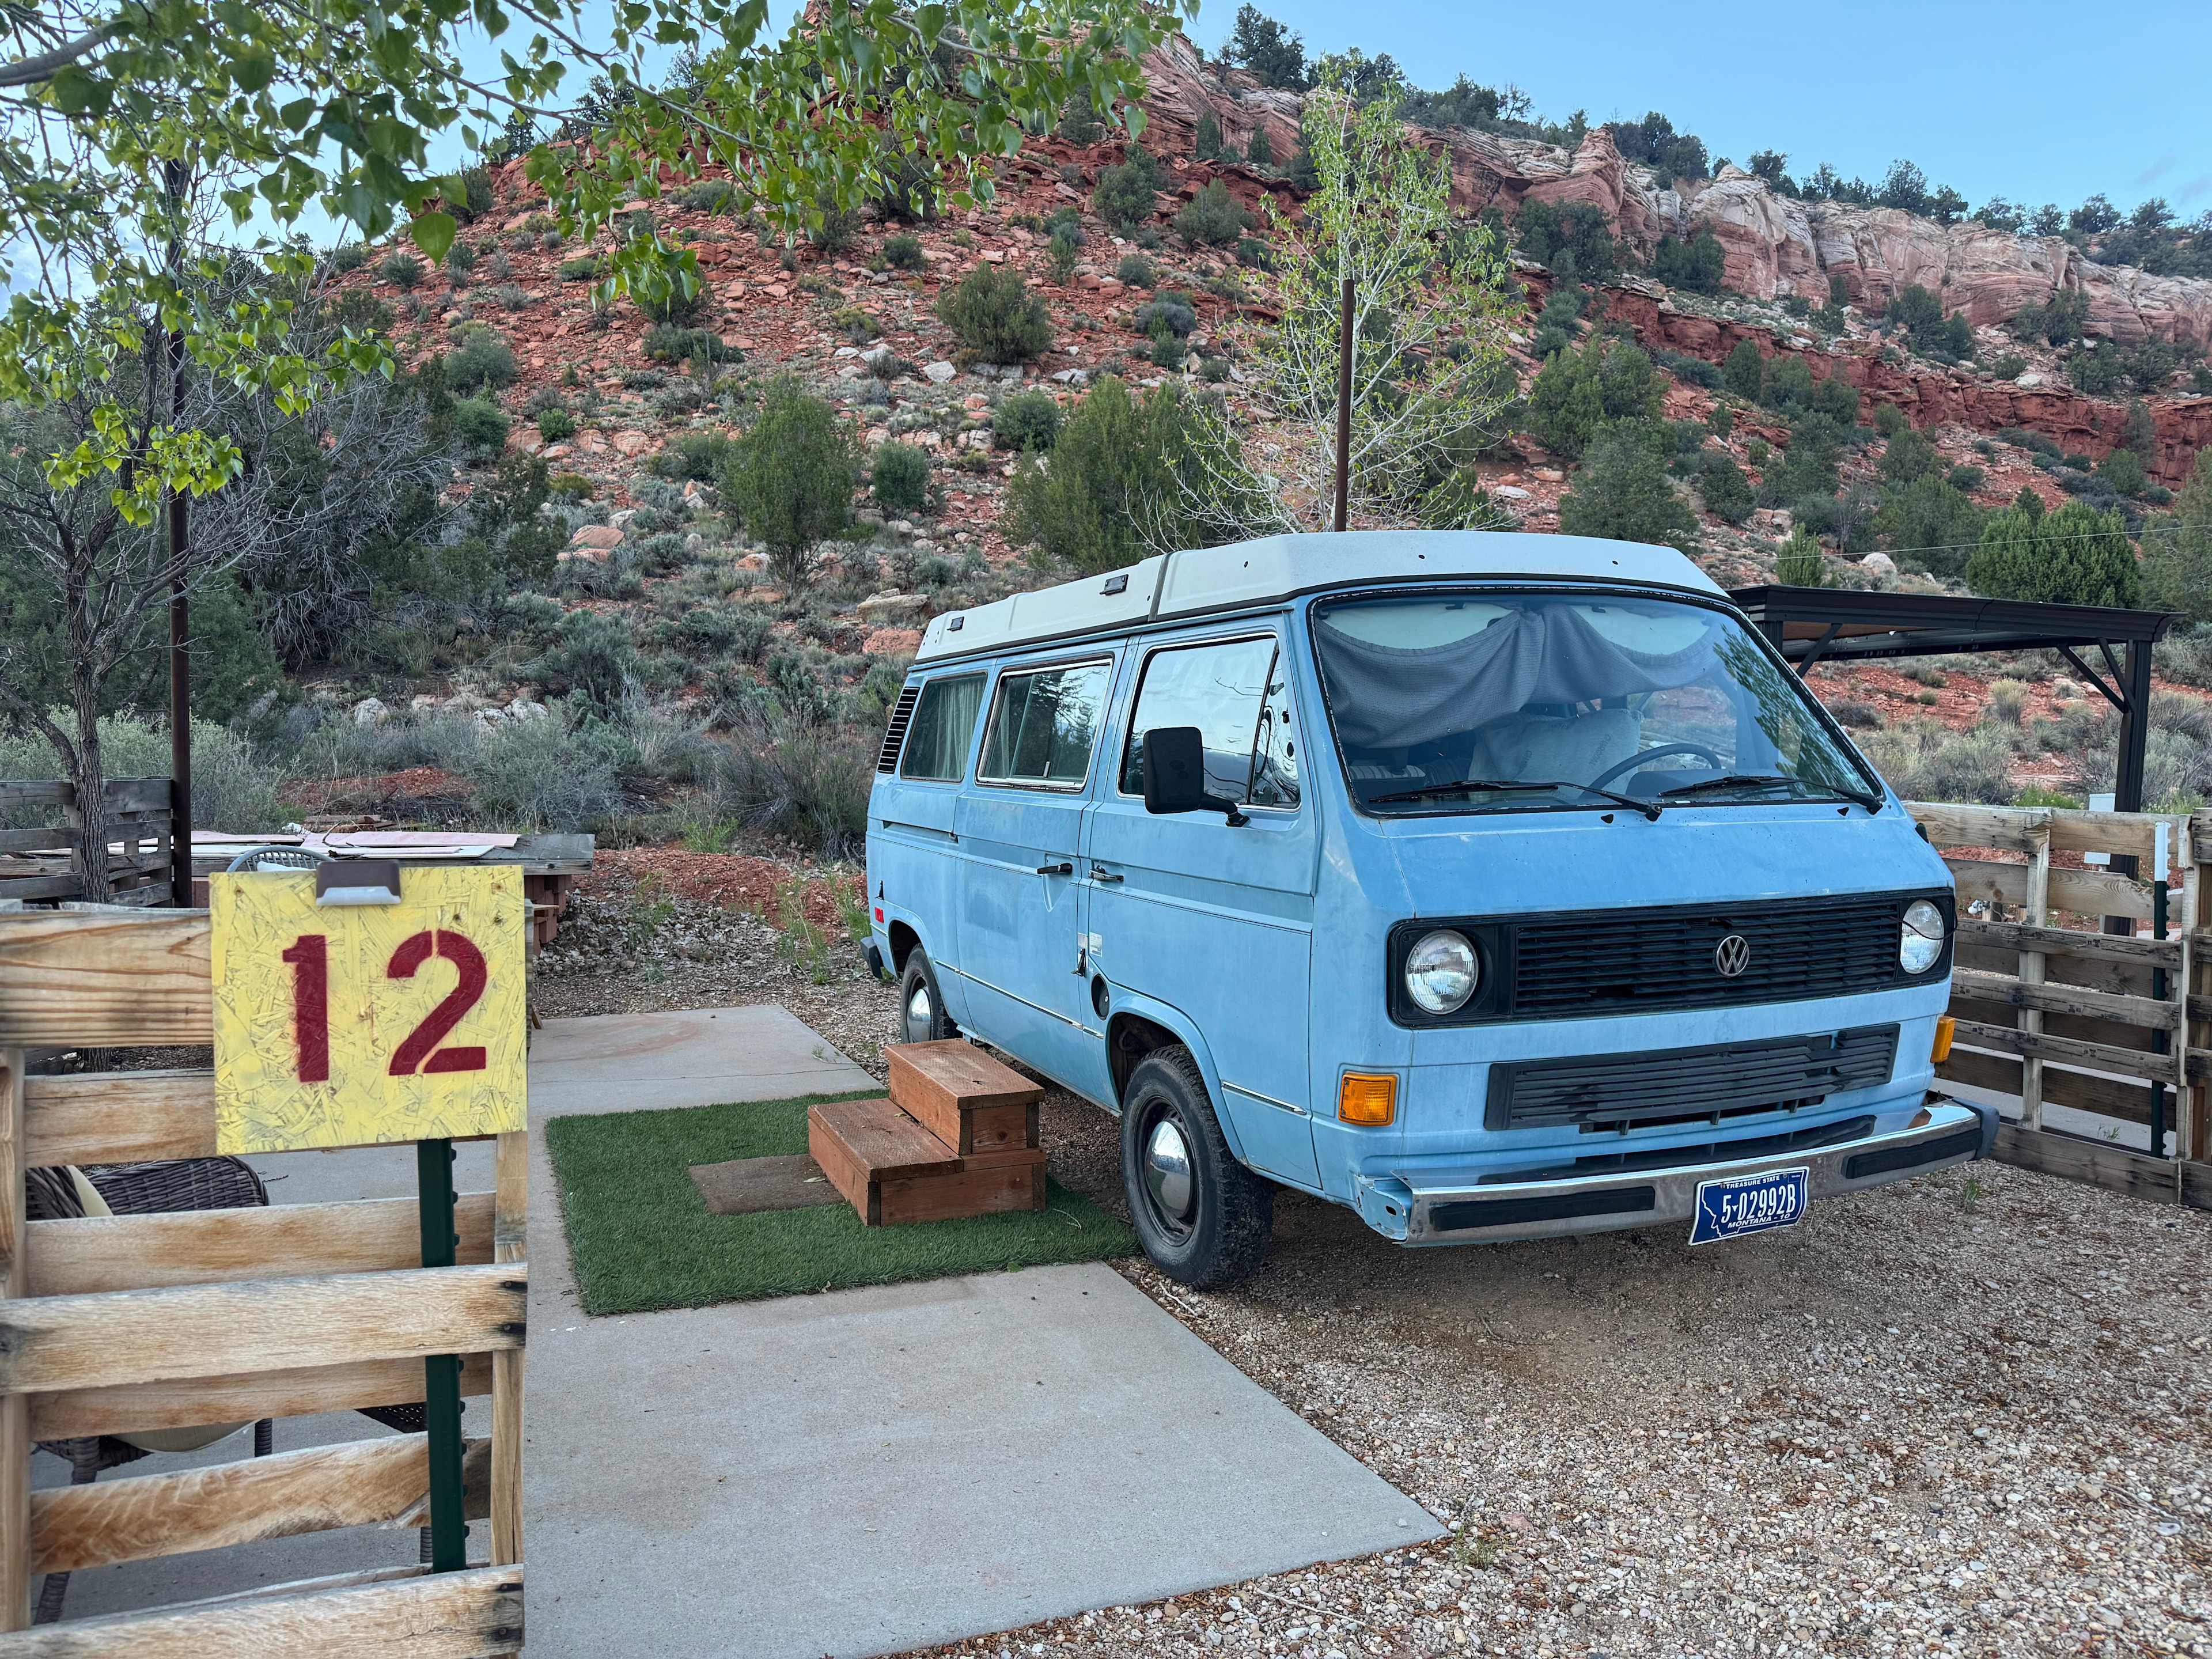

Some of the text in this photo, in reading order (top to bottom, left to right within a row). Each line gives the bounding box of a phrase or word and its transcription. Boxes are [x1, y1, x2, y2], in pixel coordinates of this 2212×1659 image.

[1717, 936, 1749, 976] VW
[282, 930, 487, 1082] 12
[1726, 1175, 1780, 1189] TREASURE STATE
[1727, 1217, 1772, 1228] MONTANA
